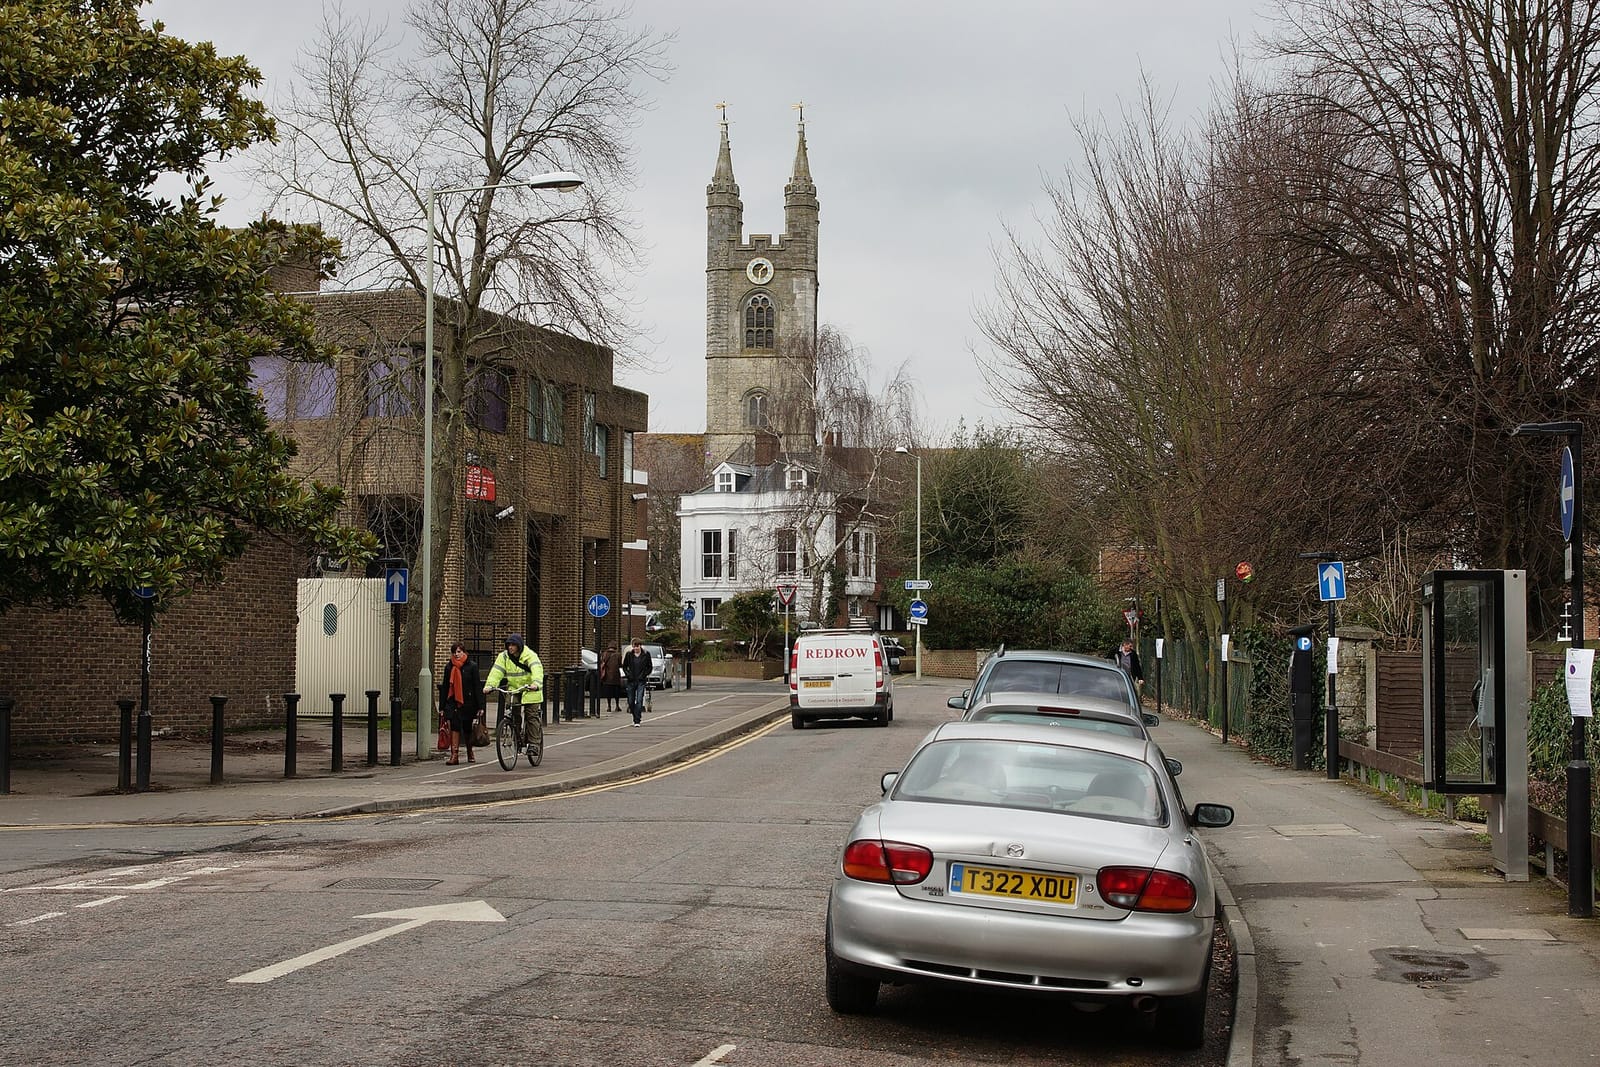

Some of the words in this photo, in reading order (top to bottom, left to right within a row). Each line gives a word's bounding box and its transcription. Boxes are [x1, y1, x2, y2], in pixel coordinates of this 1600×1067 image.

[1301, 637, 1310, 650] P
[805, 647, 868, 659] REDROW
[967, 869, 1024, 895] T322
[1030, 876, 1073, 900] XDU
